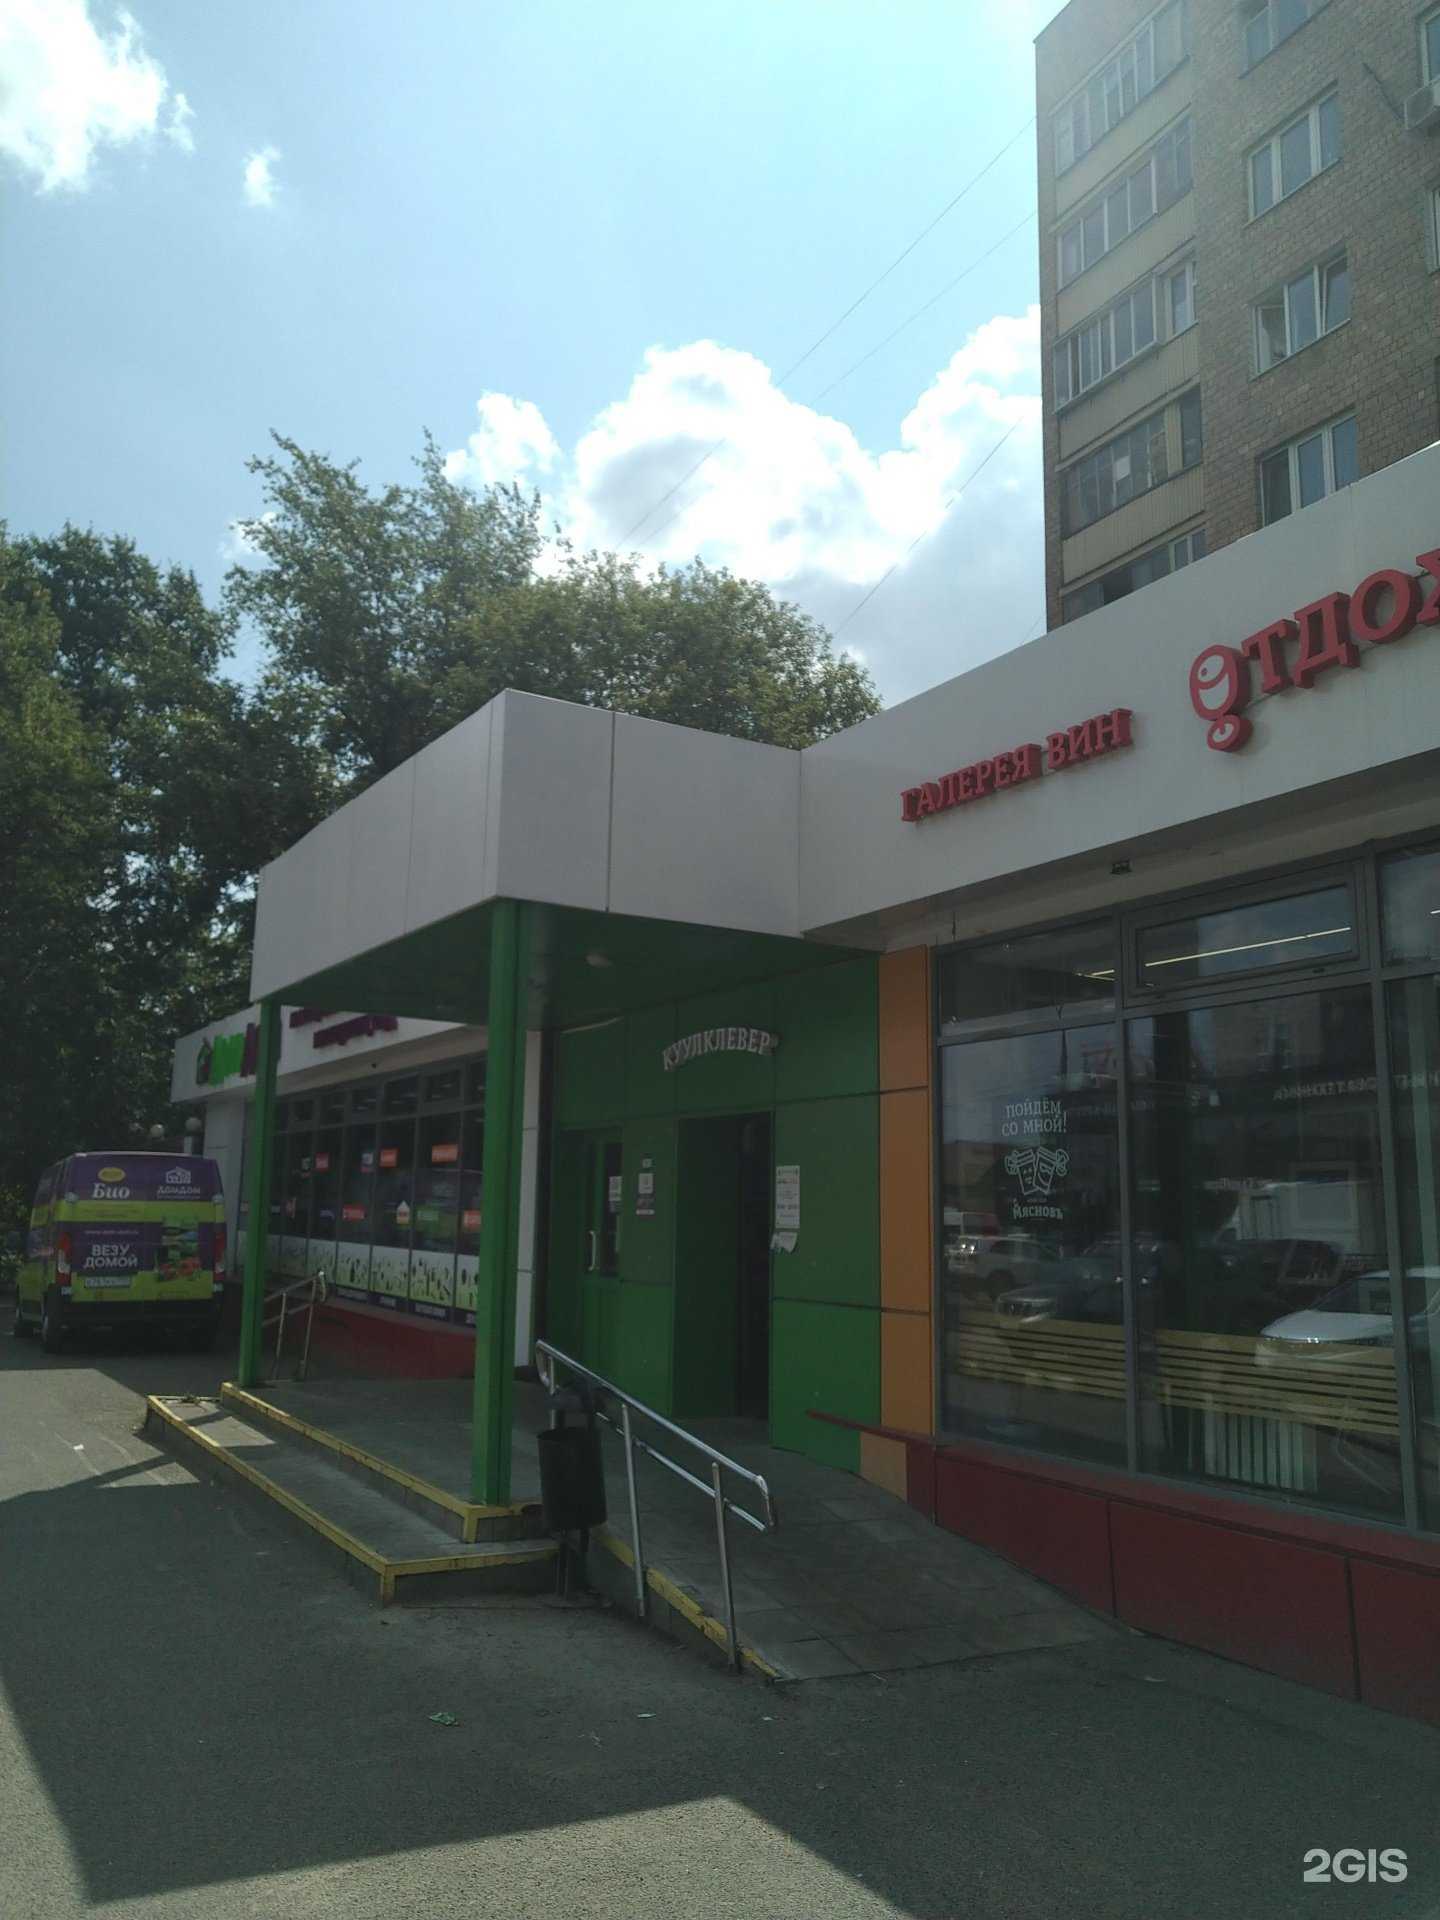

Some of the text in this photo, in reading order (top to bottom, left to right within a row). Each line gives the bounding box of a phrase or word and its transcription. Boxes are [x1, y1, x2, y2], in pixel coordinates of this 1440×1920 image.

[900, 708, 1133, 822] ГАЛЕРЕЯ ВИН
[1006, 1098, 1061, 1118] ПОЙДЁМ
[1002, 1111, 1067, 1136] СО МНОЙ!
[92, 1183, 130, 1199] Био
[92, 1244, 129, 1256] ВЕЗУ
[83, 1255, 137, 1269] ДОМОЙ
